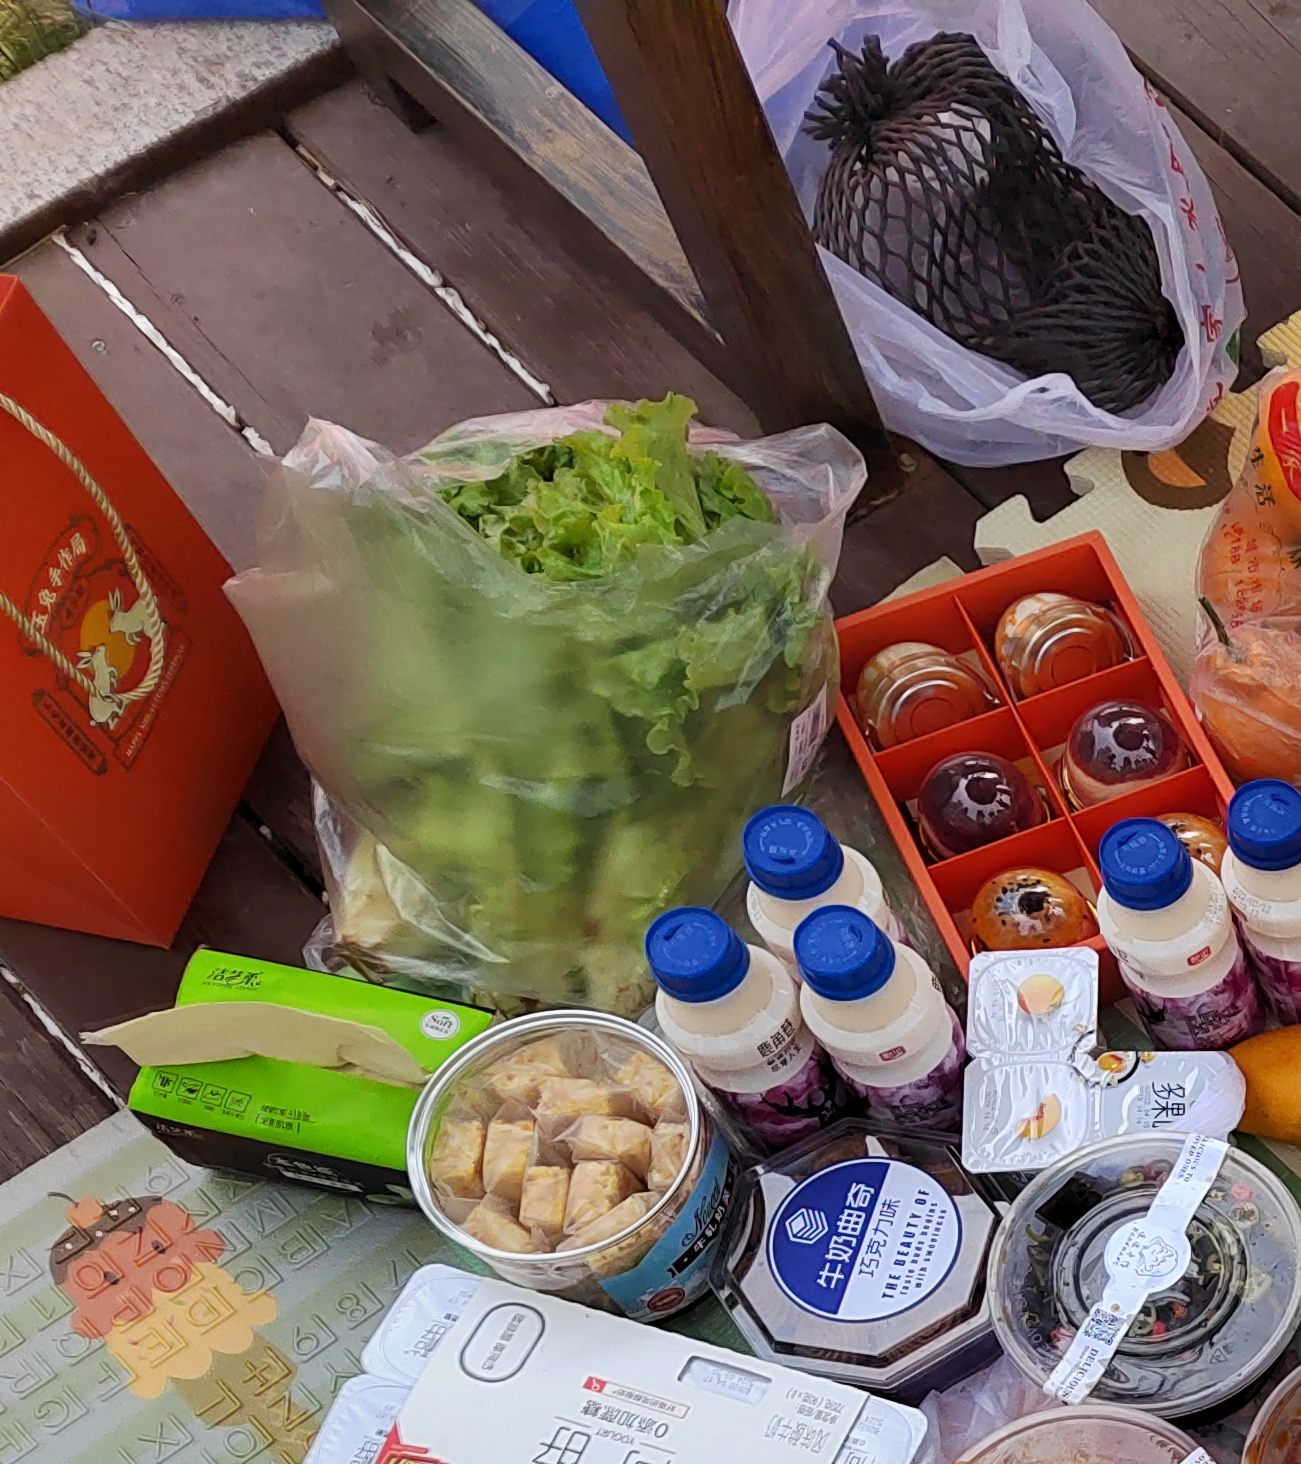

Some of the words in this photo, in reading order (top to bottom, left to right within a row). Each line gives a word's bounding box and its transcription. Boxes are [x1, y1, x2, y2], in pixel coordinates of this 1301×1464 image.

[817, 1183, 875, 1288] 牛奶曲奇
[857, 1199, 901, 1277] 巧克力味
[881, 1275, 898, 1302] THE
[893, 1211, 926, 1268] BEAUTY
[596, 1428, 635, 1447] YOGURT
